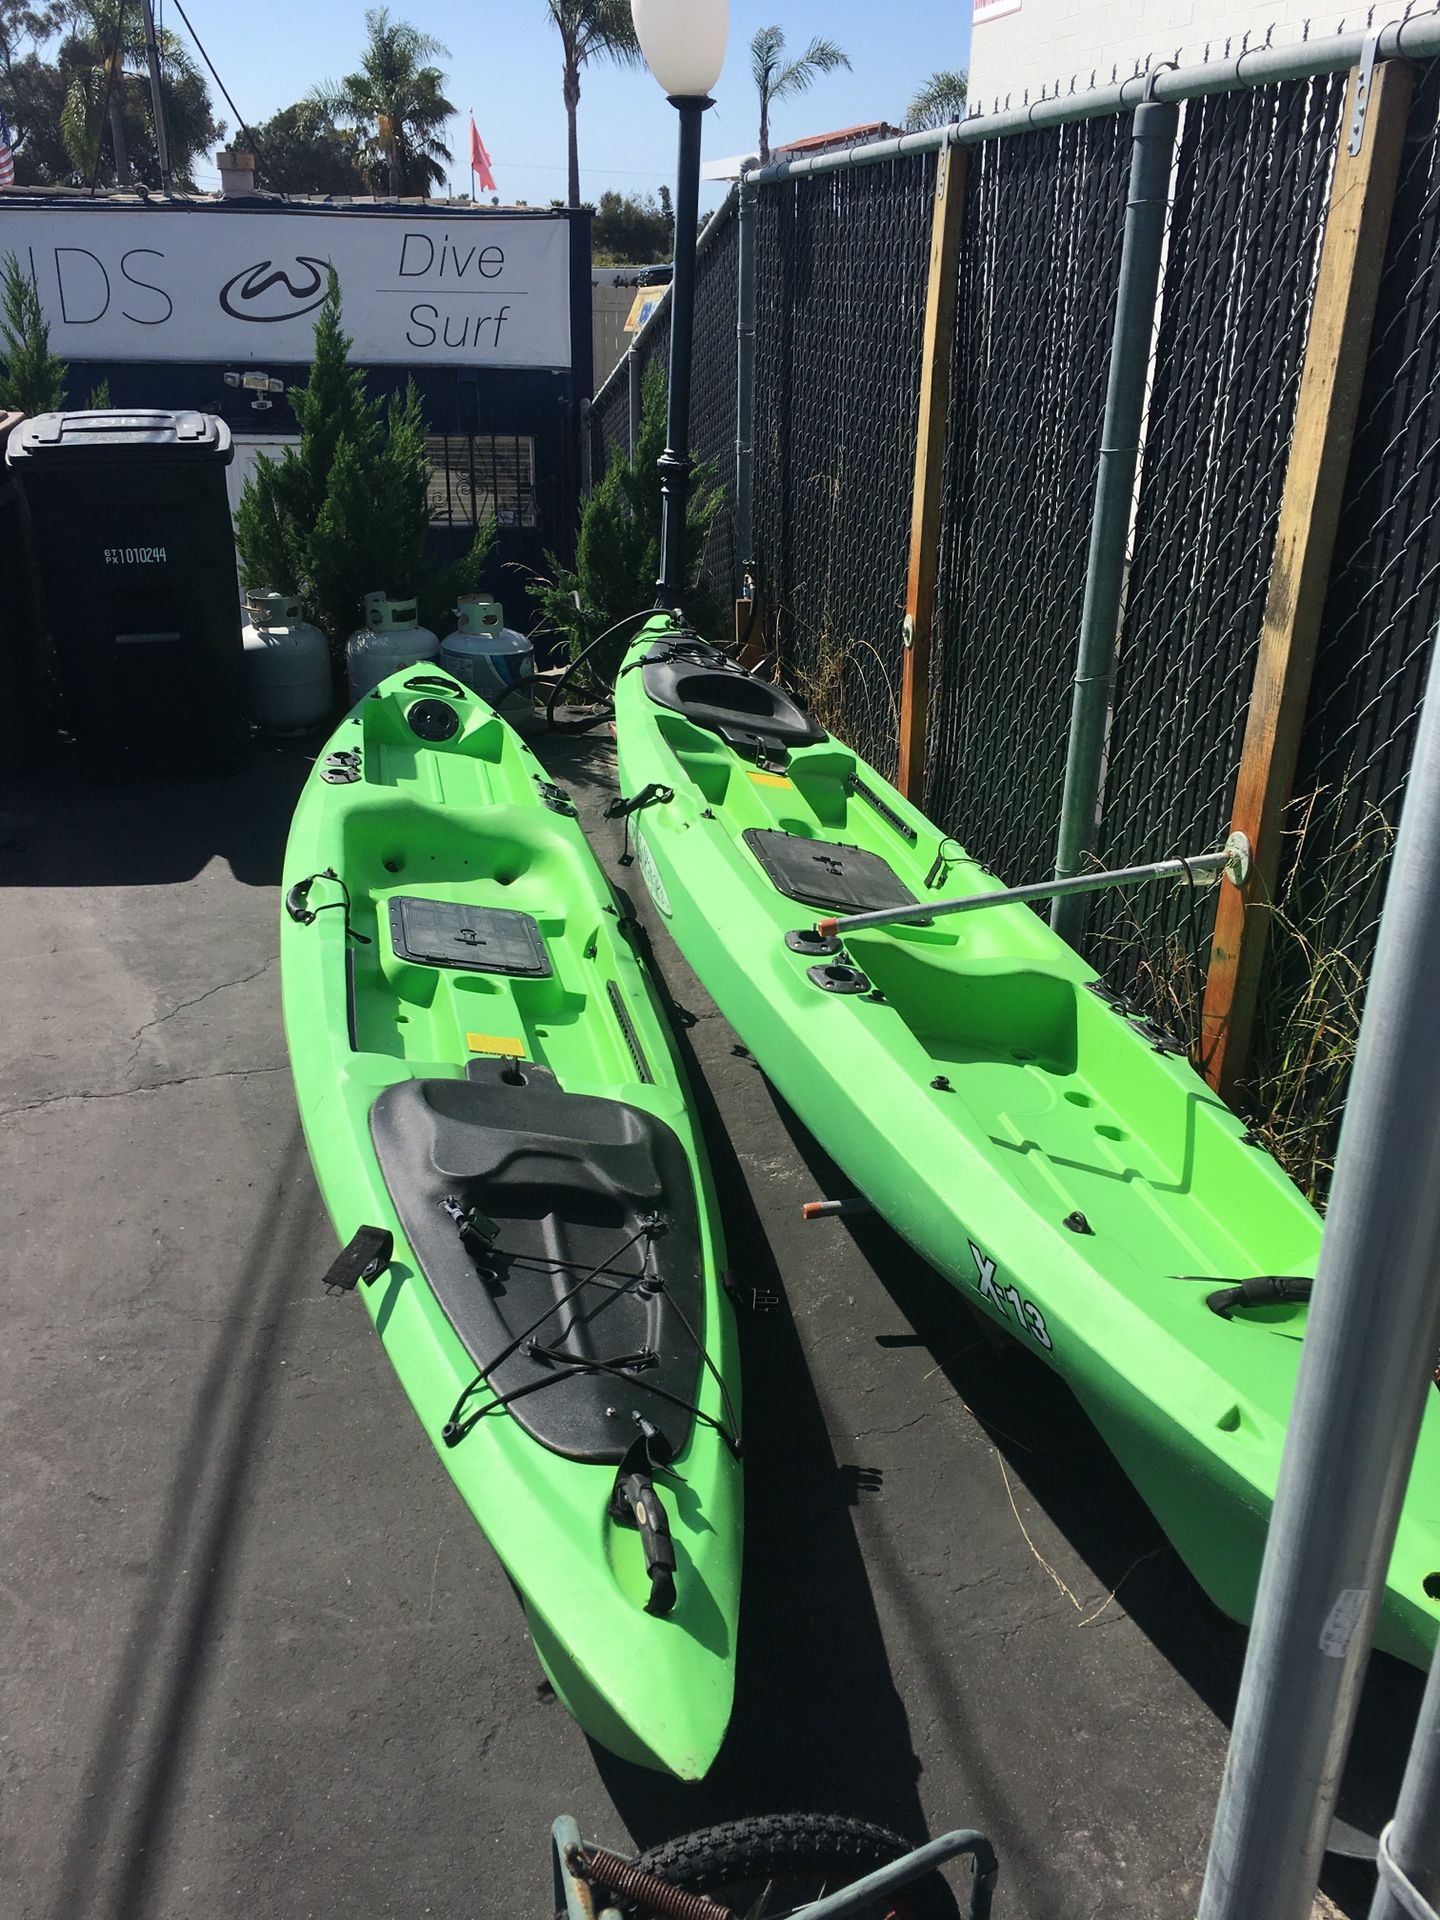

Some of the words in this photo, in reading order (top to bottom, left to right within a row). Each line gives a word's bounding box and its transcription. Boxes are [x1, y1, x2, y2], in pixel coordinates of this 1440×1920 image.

[399, 233, 505, 278] Dive
[406, 304, 511, 348] Surf
[118, 547, 167, 564] 1010244
[967, 1238, 1054, 1351] X-13
